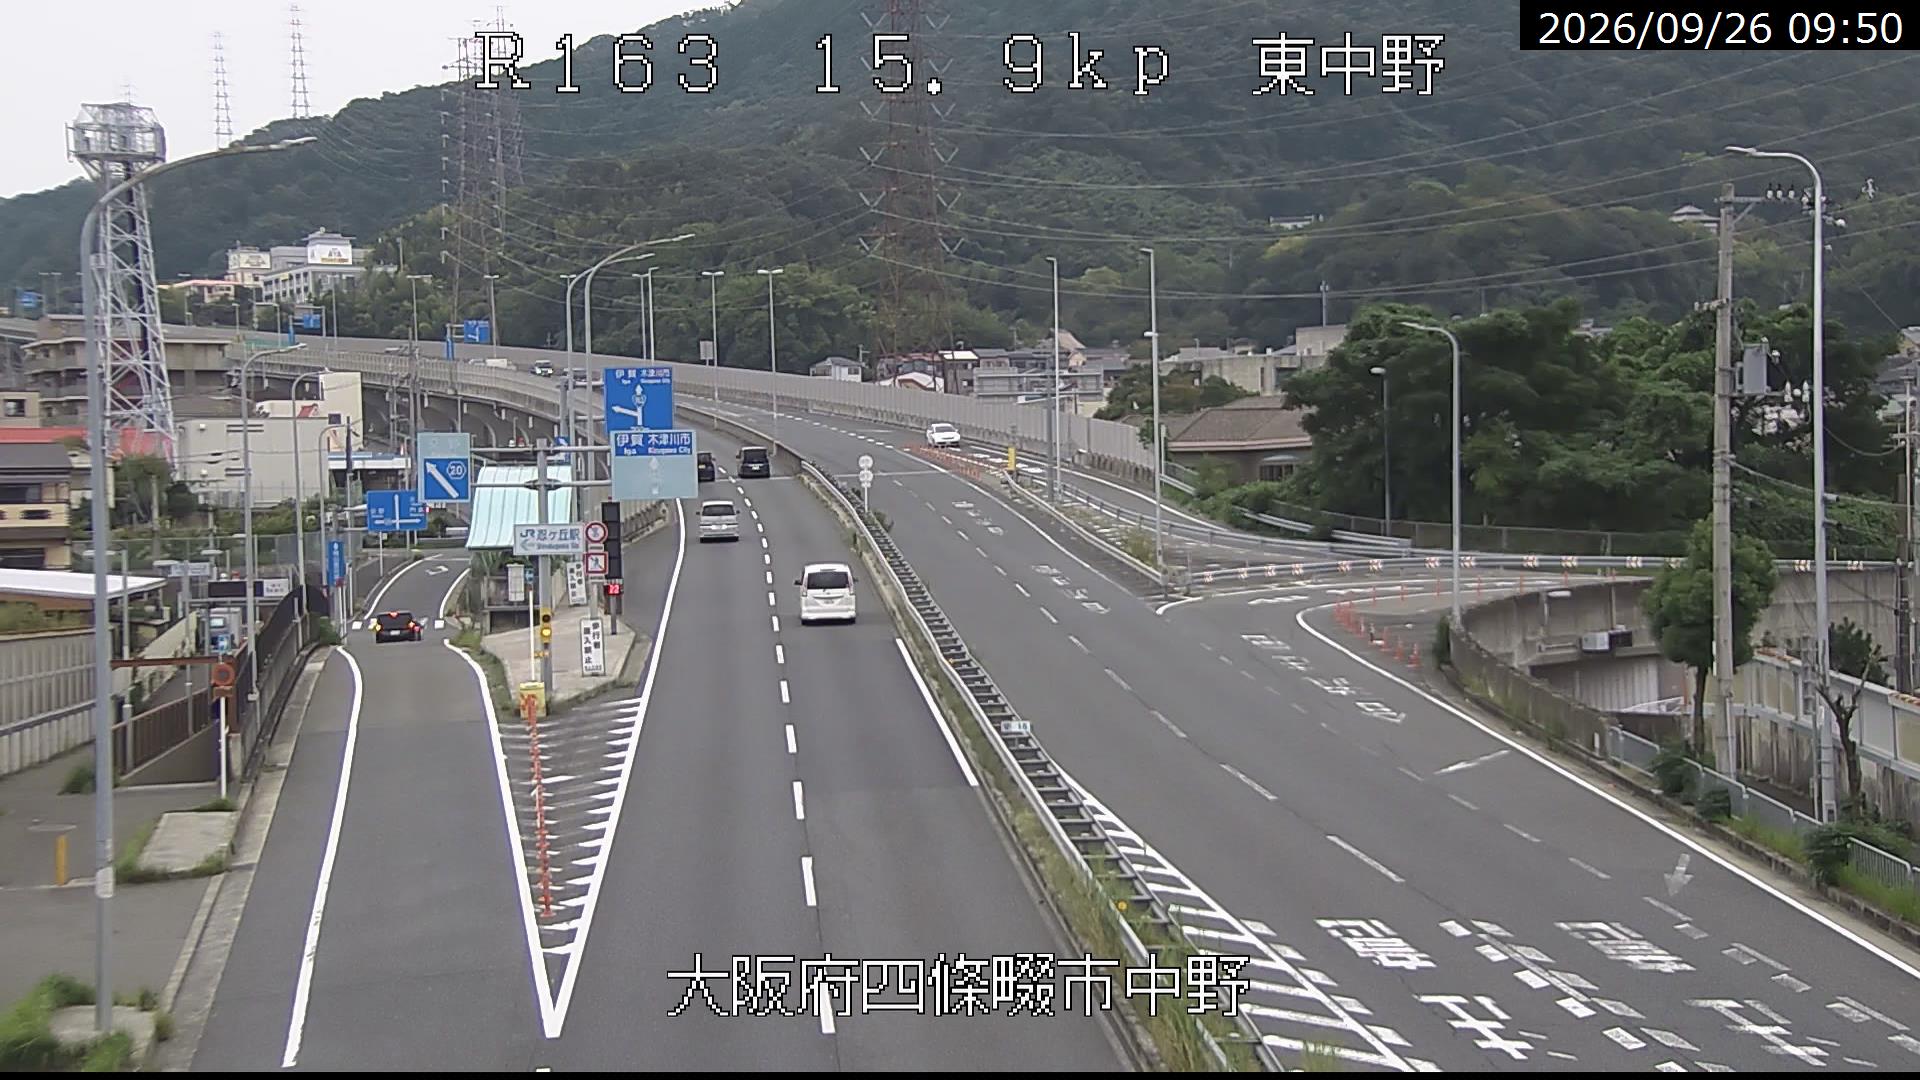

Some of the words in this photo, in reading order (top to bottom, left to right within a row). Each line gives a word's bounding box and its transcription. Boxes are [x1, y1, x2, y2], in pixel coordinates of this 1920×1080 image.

[616, 433, 644, 447] 伊賀
[647, 433, 691, 446] 木津川市
[450, 465, 462, 475] 20
